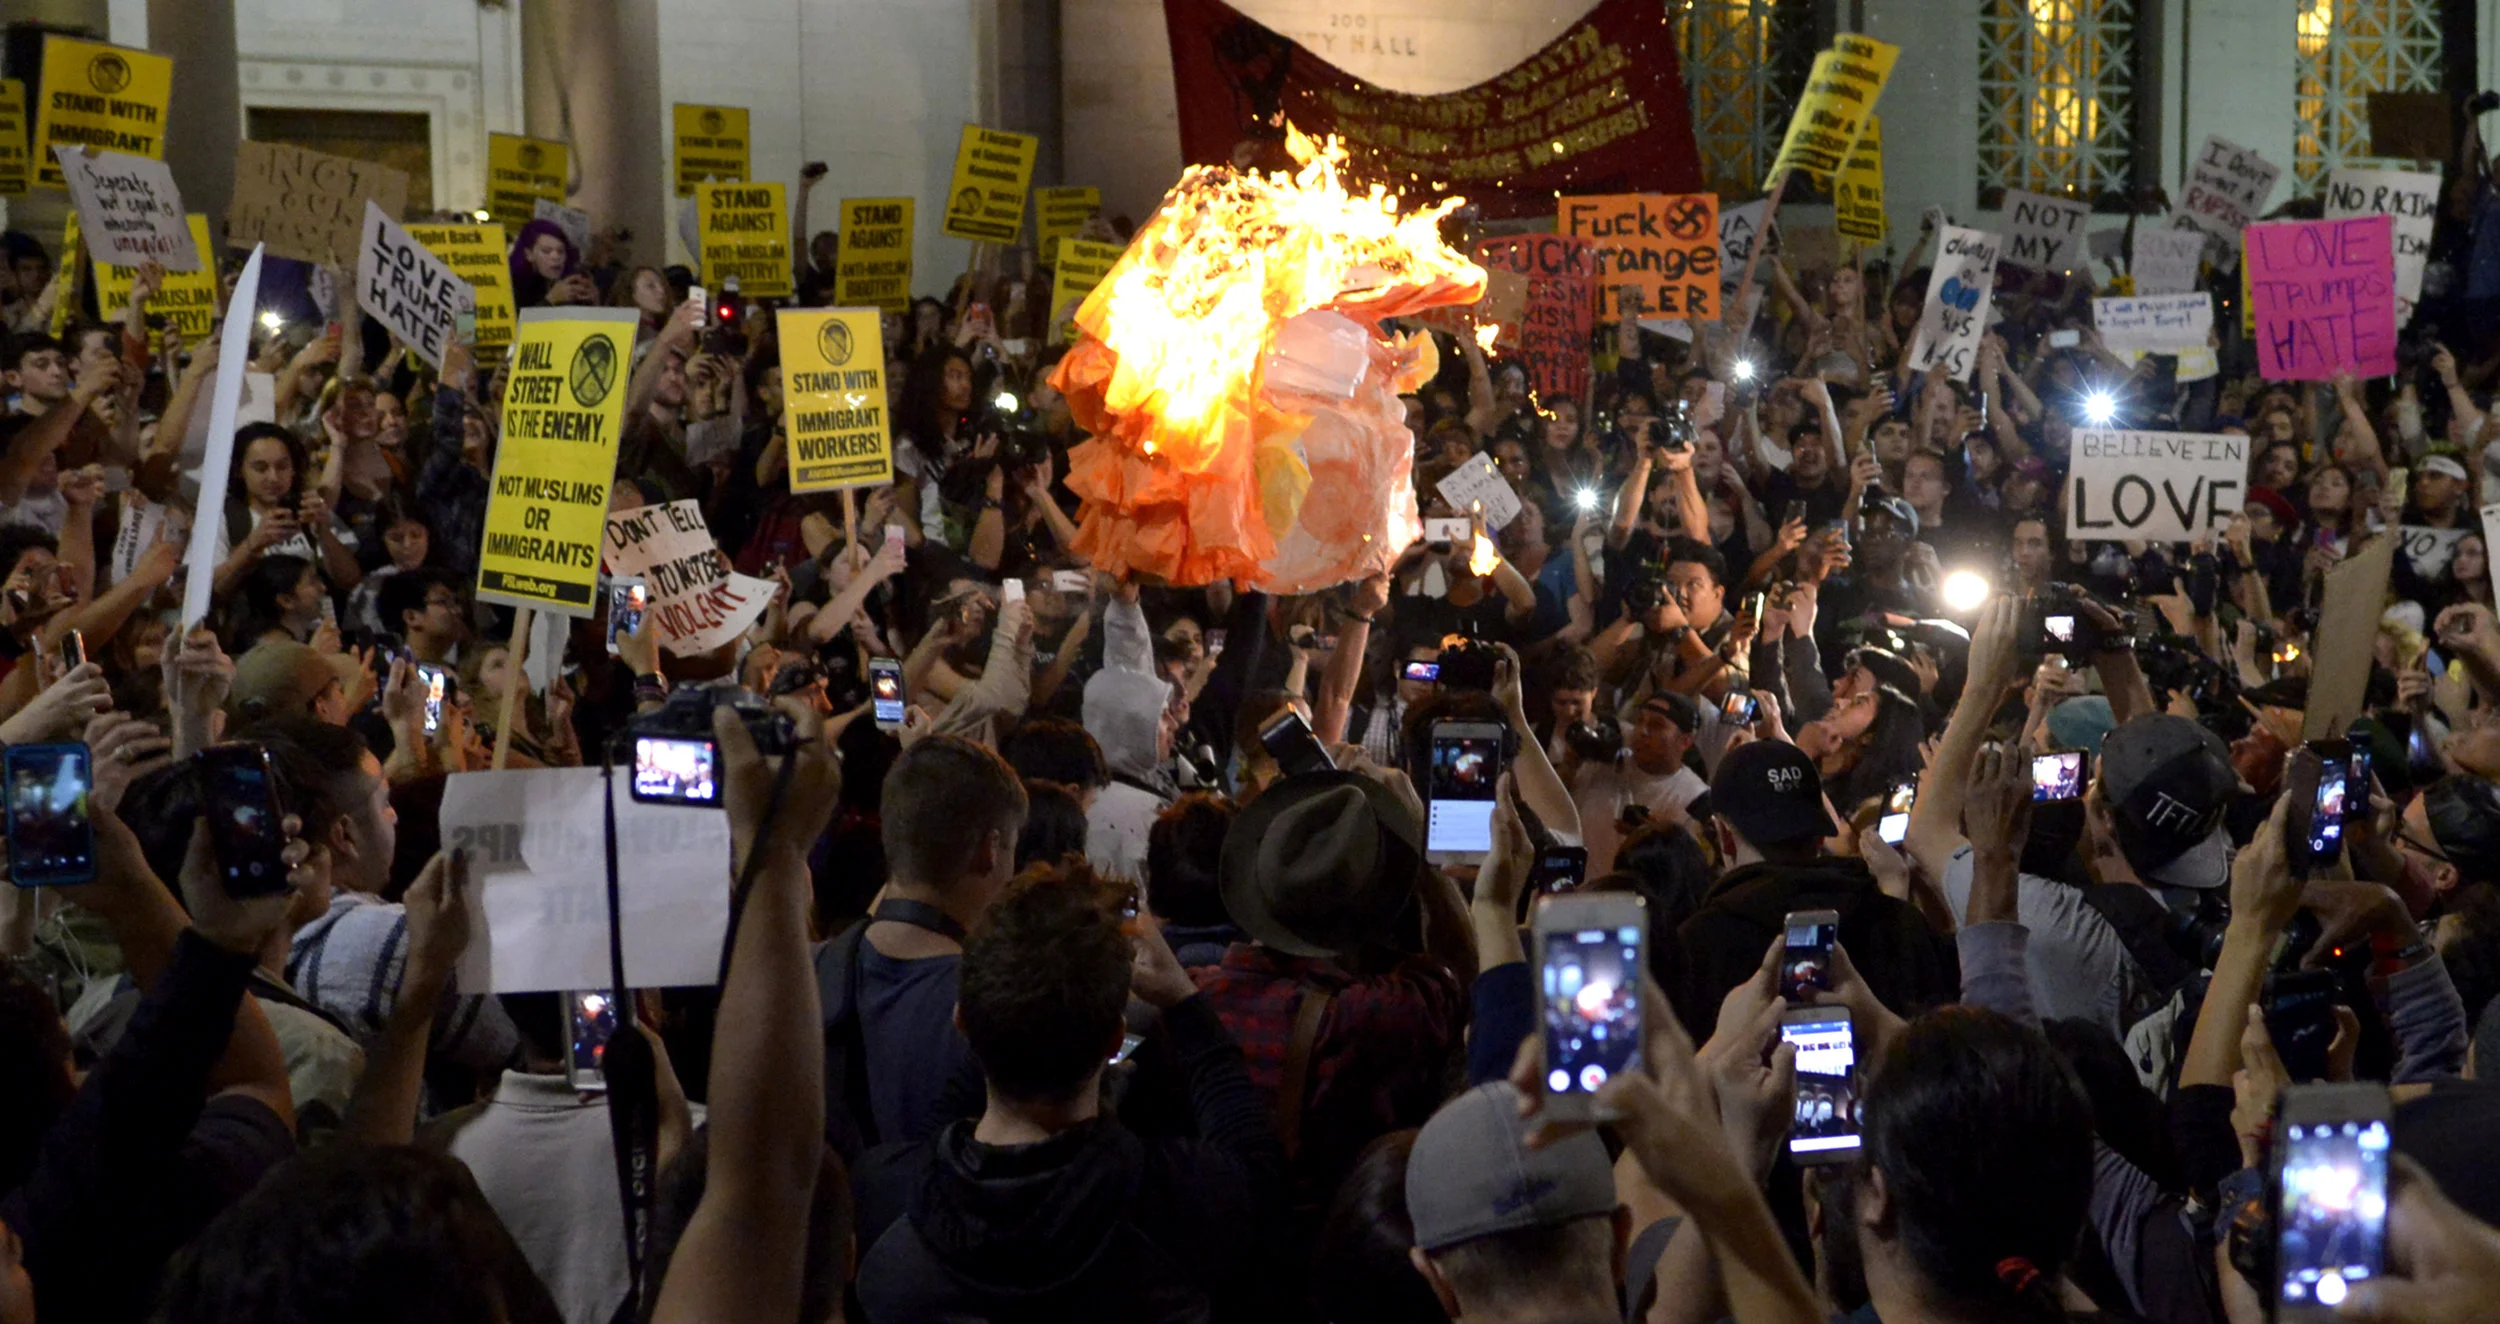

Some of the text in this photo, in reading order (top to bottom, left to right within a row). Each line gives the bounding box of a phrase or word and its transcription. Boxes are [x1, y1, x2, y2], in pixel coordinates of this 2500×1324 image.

[1331, 13, 1366, 28] 200
[1351, 33, 1416, 56] HALL
[52, 91, 158, 124] STAND WITH
[48, 123, 154, 154] IMMIGRANT
[710, 188, 771, 209] STAND
[2329, 182, 2366, 212] NO
[709, 212, 777, 232] AGAINST
[853, 204, 903, 226] STAND
[1569, 201, 1662, 239] Fuck
[2014, 201, 2083, 234] NOT
[449, 230, 483, 244] Back
[848, 227, 904, 251] AGAINST
[2011, 234, 2062, 264] MY
[2257, 217, 2380, 273] LOVE
[376, 221, 456, 310] LOVE
[1484, 237, 1584, 275] FUCK
[1598, 246, 1718, 282] range
[372, 247, 453, 330] TRUMP
[1526, 279, 1589, 310] CISM
[1599, 283, 1709, 316] ITLER
[370, 278, 442, 359] HATE
[2268, 305, 2383, 371] HATE
[518, 341, 553, 371] WALL
[510, 376, 564, 405] STREET
[792, 369, 879, 393] STAND WITH
[506, 409, 607, 447] IS THE ENEMY,
[796, 407, 881, 434] IMMIGRANT
[797, 432, 882, 462] WORKERS!
[2082, 433, 2243, 461] BELIEVE IN
[496, 475, 604, 506] NOT MUSLIMS
[2075, 473, 2238, 533] LOVE
[524, 506, 551, 533] OR
[660, 501, 705, 533] TELL
[486, 532, 595, 569] IMMIGRANTS
[649, 563, 680, 598] TO
[673, 554, 706, 591] NOT
[655, 582, 747, 641] VIOLENT
[1767, 766, 1803, 784] SAD
